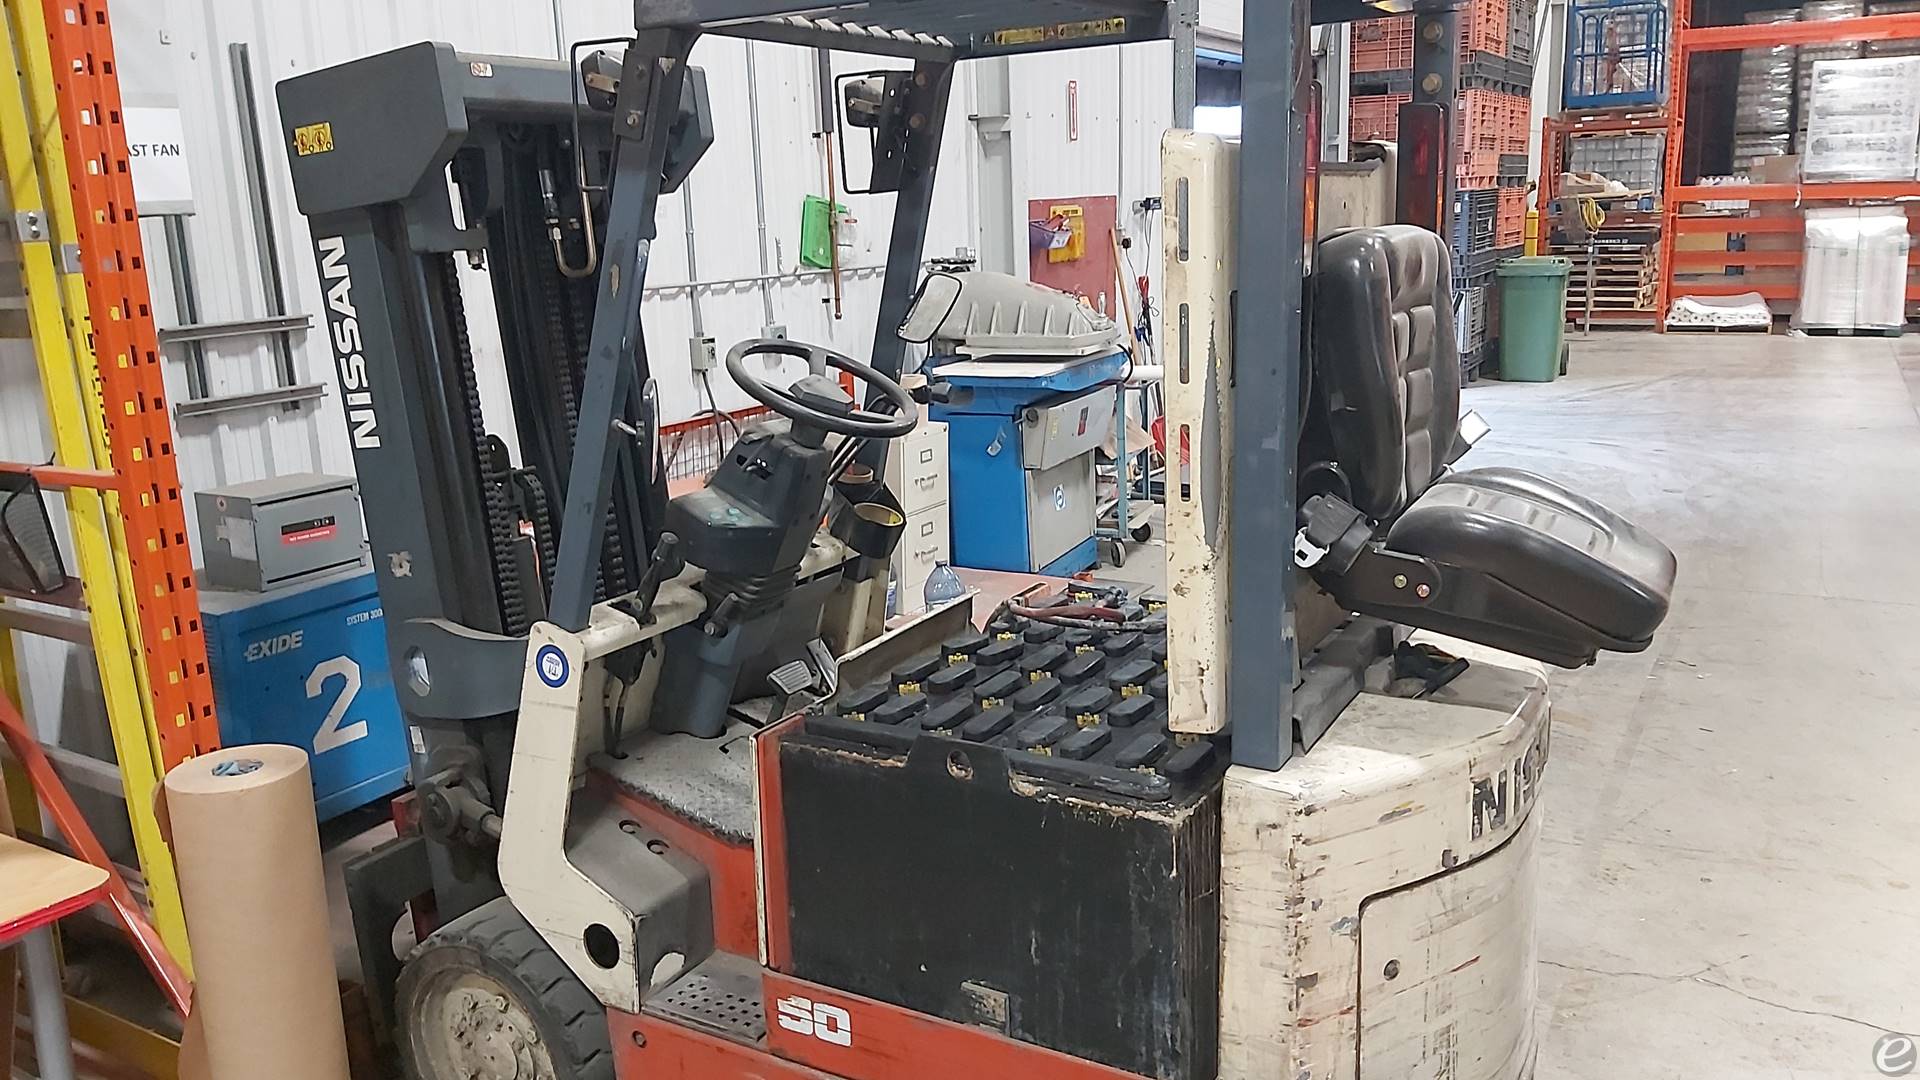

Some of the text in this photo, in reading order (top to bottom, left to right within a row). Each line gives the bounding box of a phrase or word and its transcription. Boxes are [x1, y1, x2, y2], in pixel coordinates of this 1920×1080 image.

[152, 143, 180, 157] FAN
[318, 236, 381, 448] NISSAN
[346, 611, 370, 626] SYSTEM
[244, 629, 304, 662] EXIDE
[305, 655, 368, 755] 2
